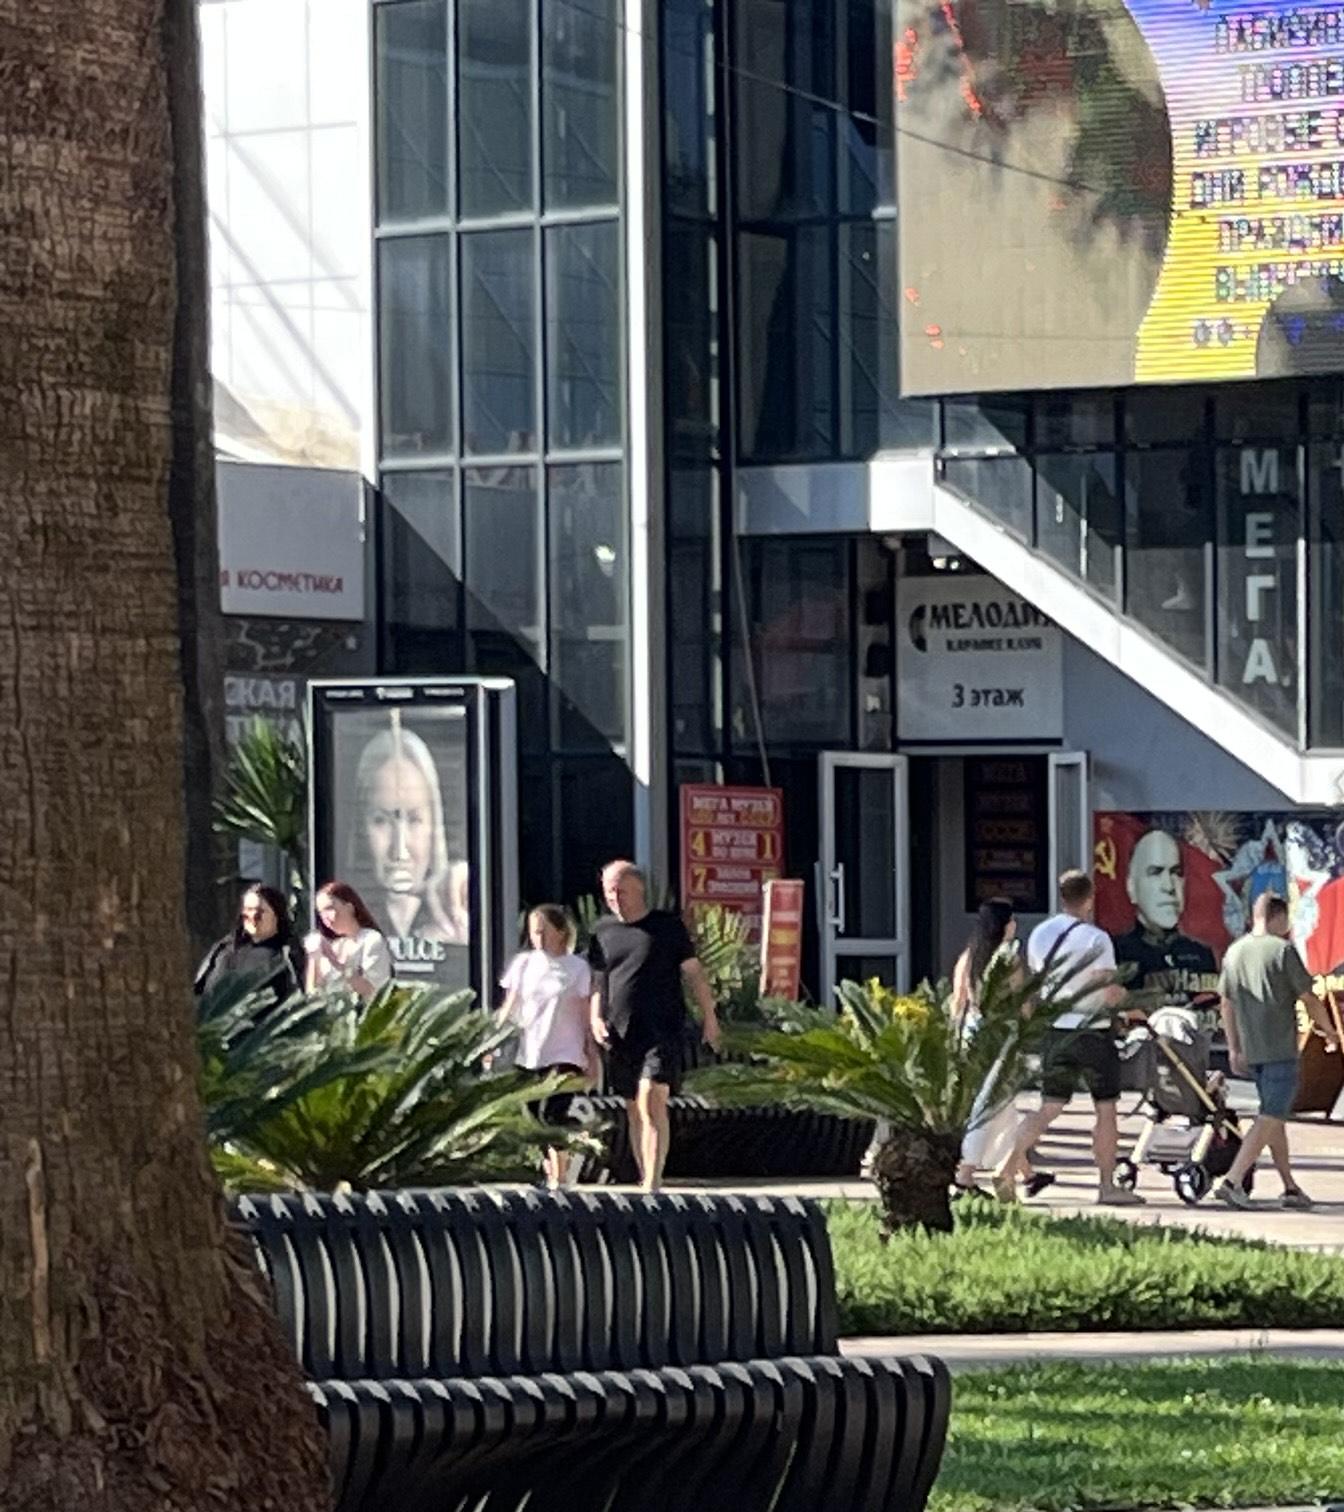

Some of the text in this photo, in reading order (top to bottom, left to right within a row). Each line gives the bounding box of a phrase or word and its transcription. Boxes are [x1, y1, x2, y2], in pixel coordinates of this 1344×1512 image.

[1240, 448, 1279, 685] МЕГА
[237, 570, 343, 593] КОСМЕТИКА
[929, 602, 1049, 630] МЕЛОДИ
[952, 683, 1024, 708] 3 этаж
